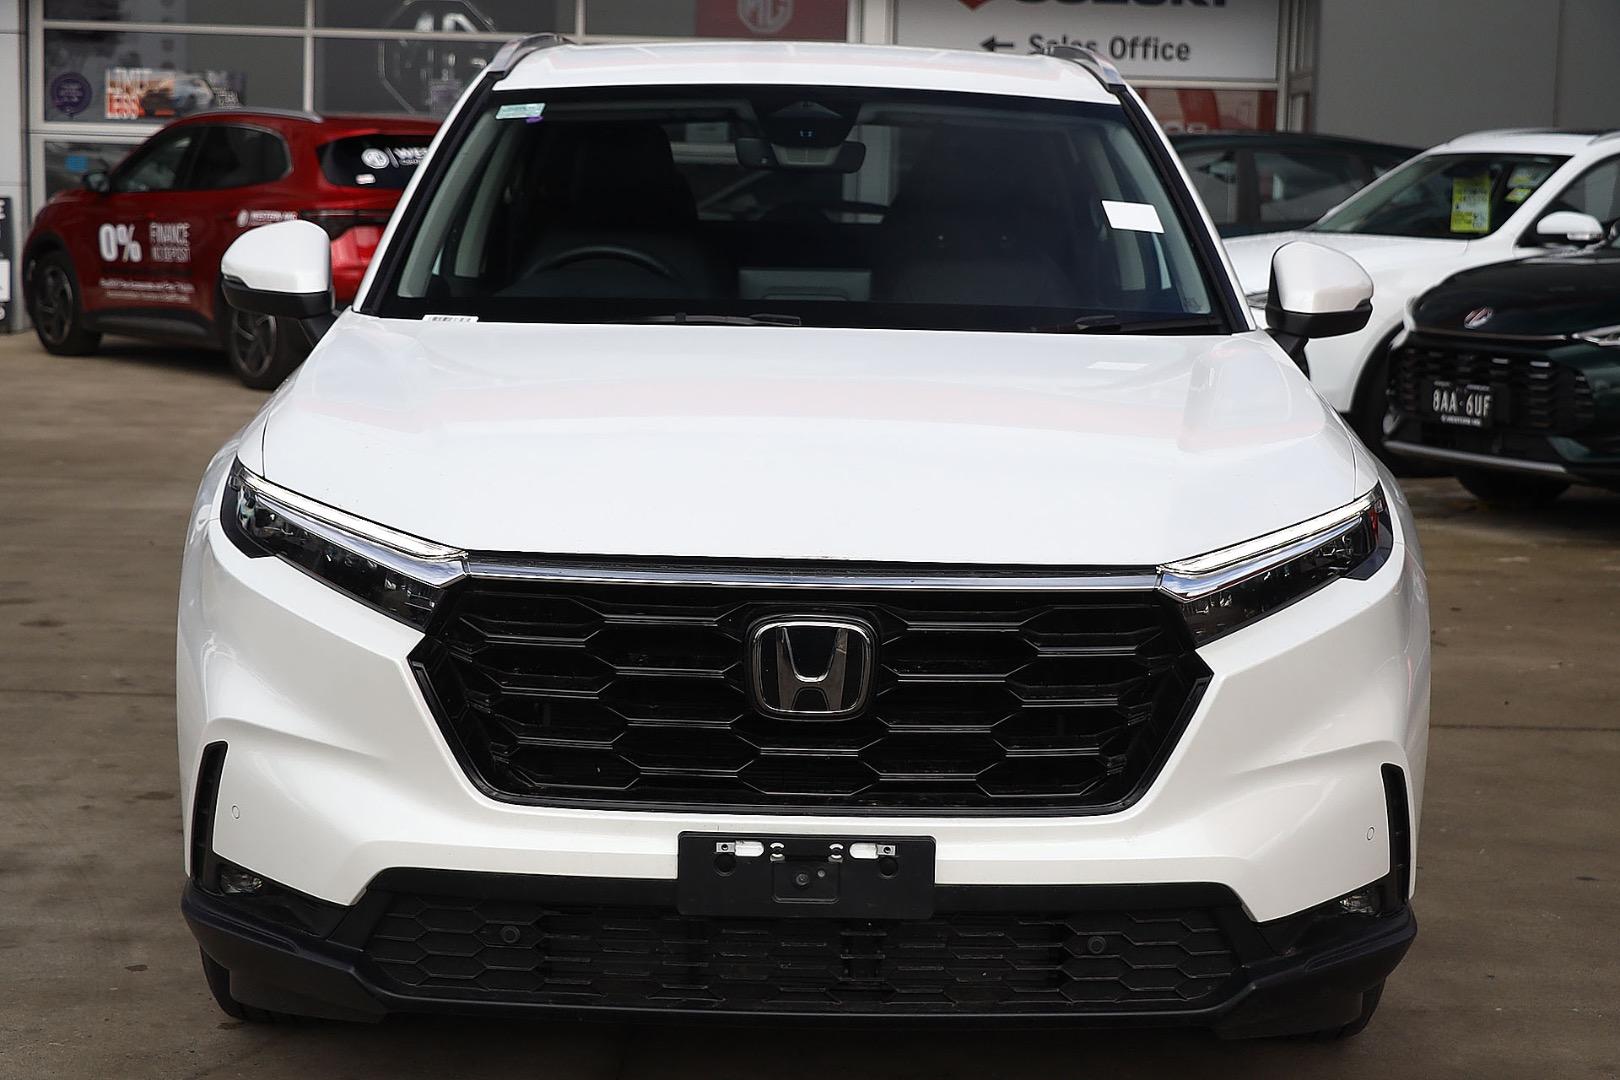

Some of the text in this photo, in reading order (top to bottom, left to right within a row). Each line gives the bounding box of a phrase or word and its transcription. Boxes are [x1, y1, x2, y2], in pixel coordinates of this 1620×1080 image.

[1109, 35, 1191, 61] Office
[98, 223, 142, 262] 0%
[149, 222, 191, 244] FINANCE
